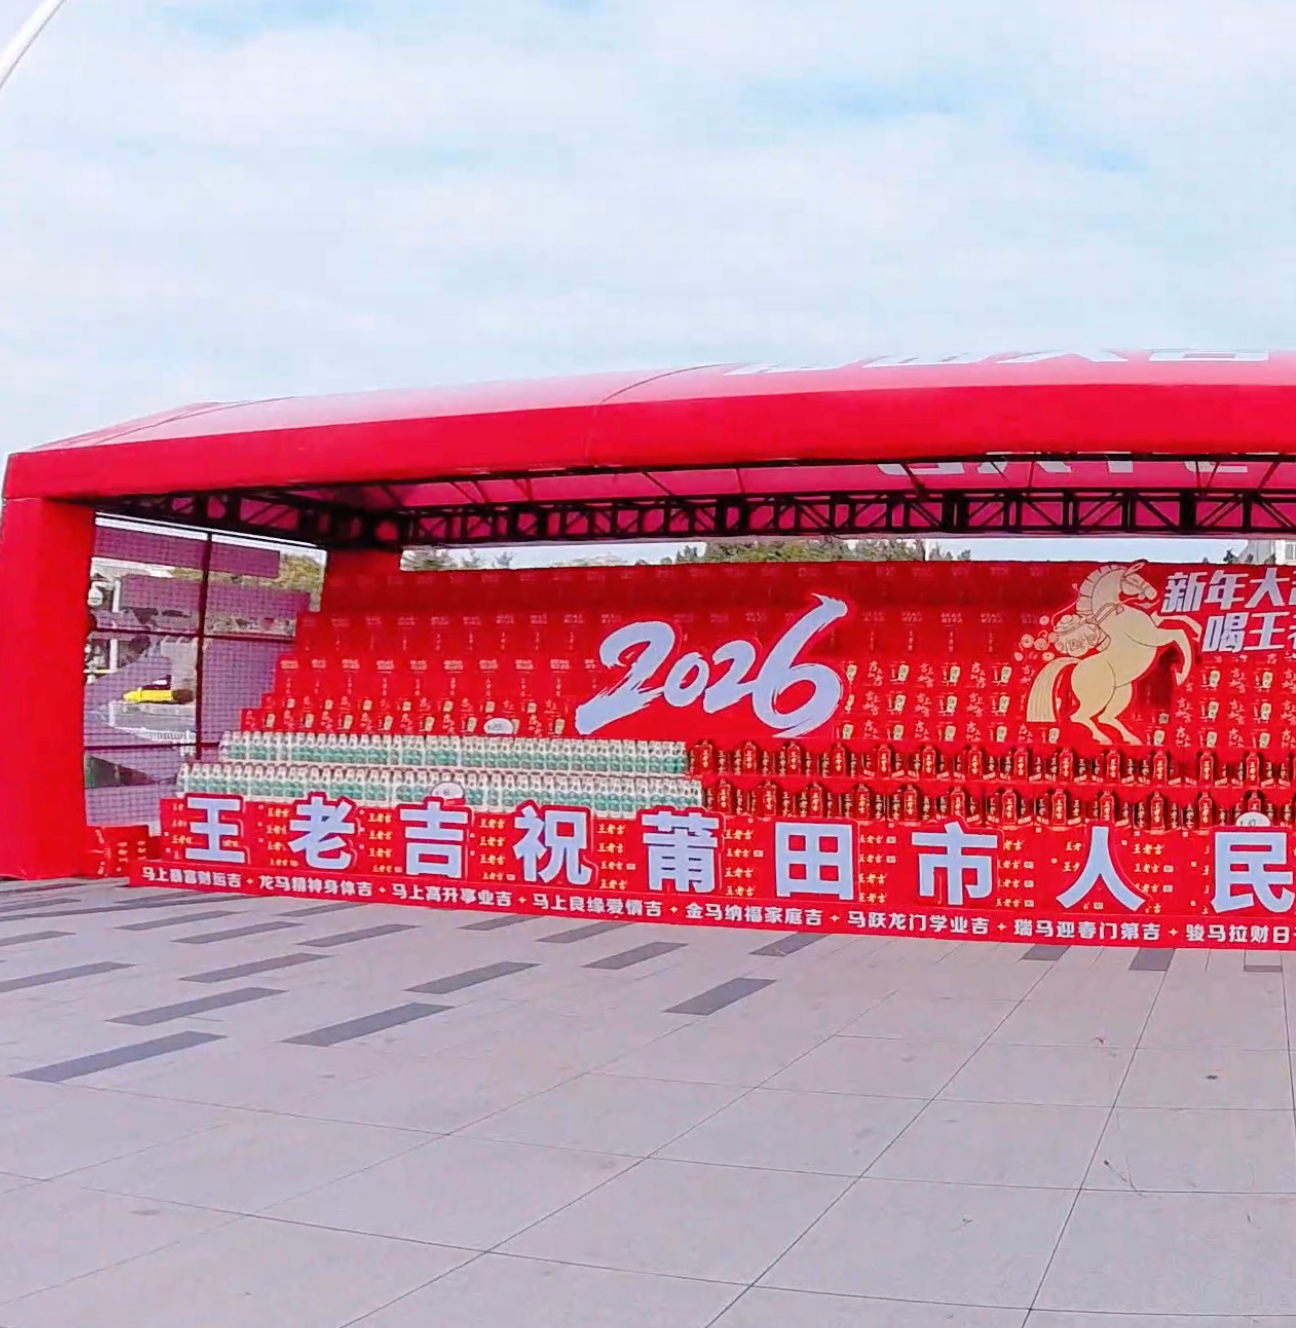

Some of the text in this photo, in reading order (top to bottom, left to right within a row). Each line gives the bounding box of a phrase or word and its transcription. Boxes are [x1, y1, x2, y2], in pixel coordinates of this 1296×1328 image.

[574, 592, 848, 739] 2026
[391, 883, 512, 907] 马上高升事业吉
[532, 893, 663, 917] 马上良缘爱情吉
[685, 902, 823, 926] 金马纳福家庭吉
[847, 910, 990, 935] 马跃龙门学业吉
[1013, 918, 1161, 941] 瑞马迎春门第吉
